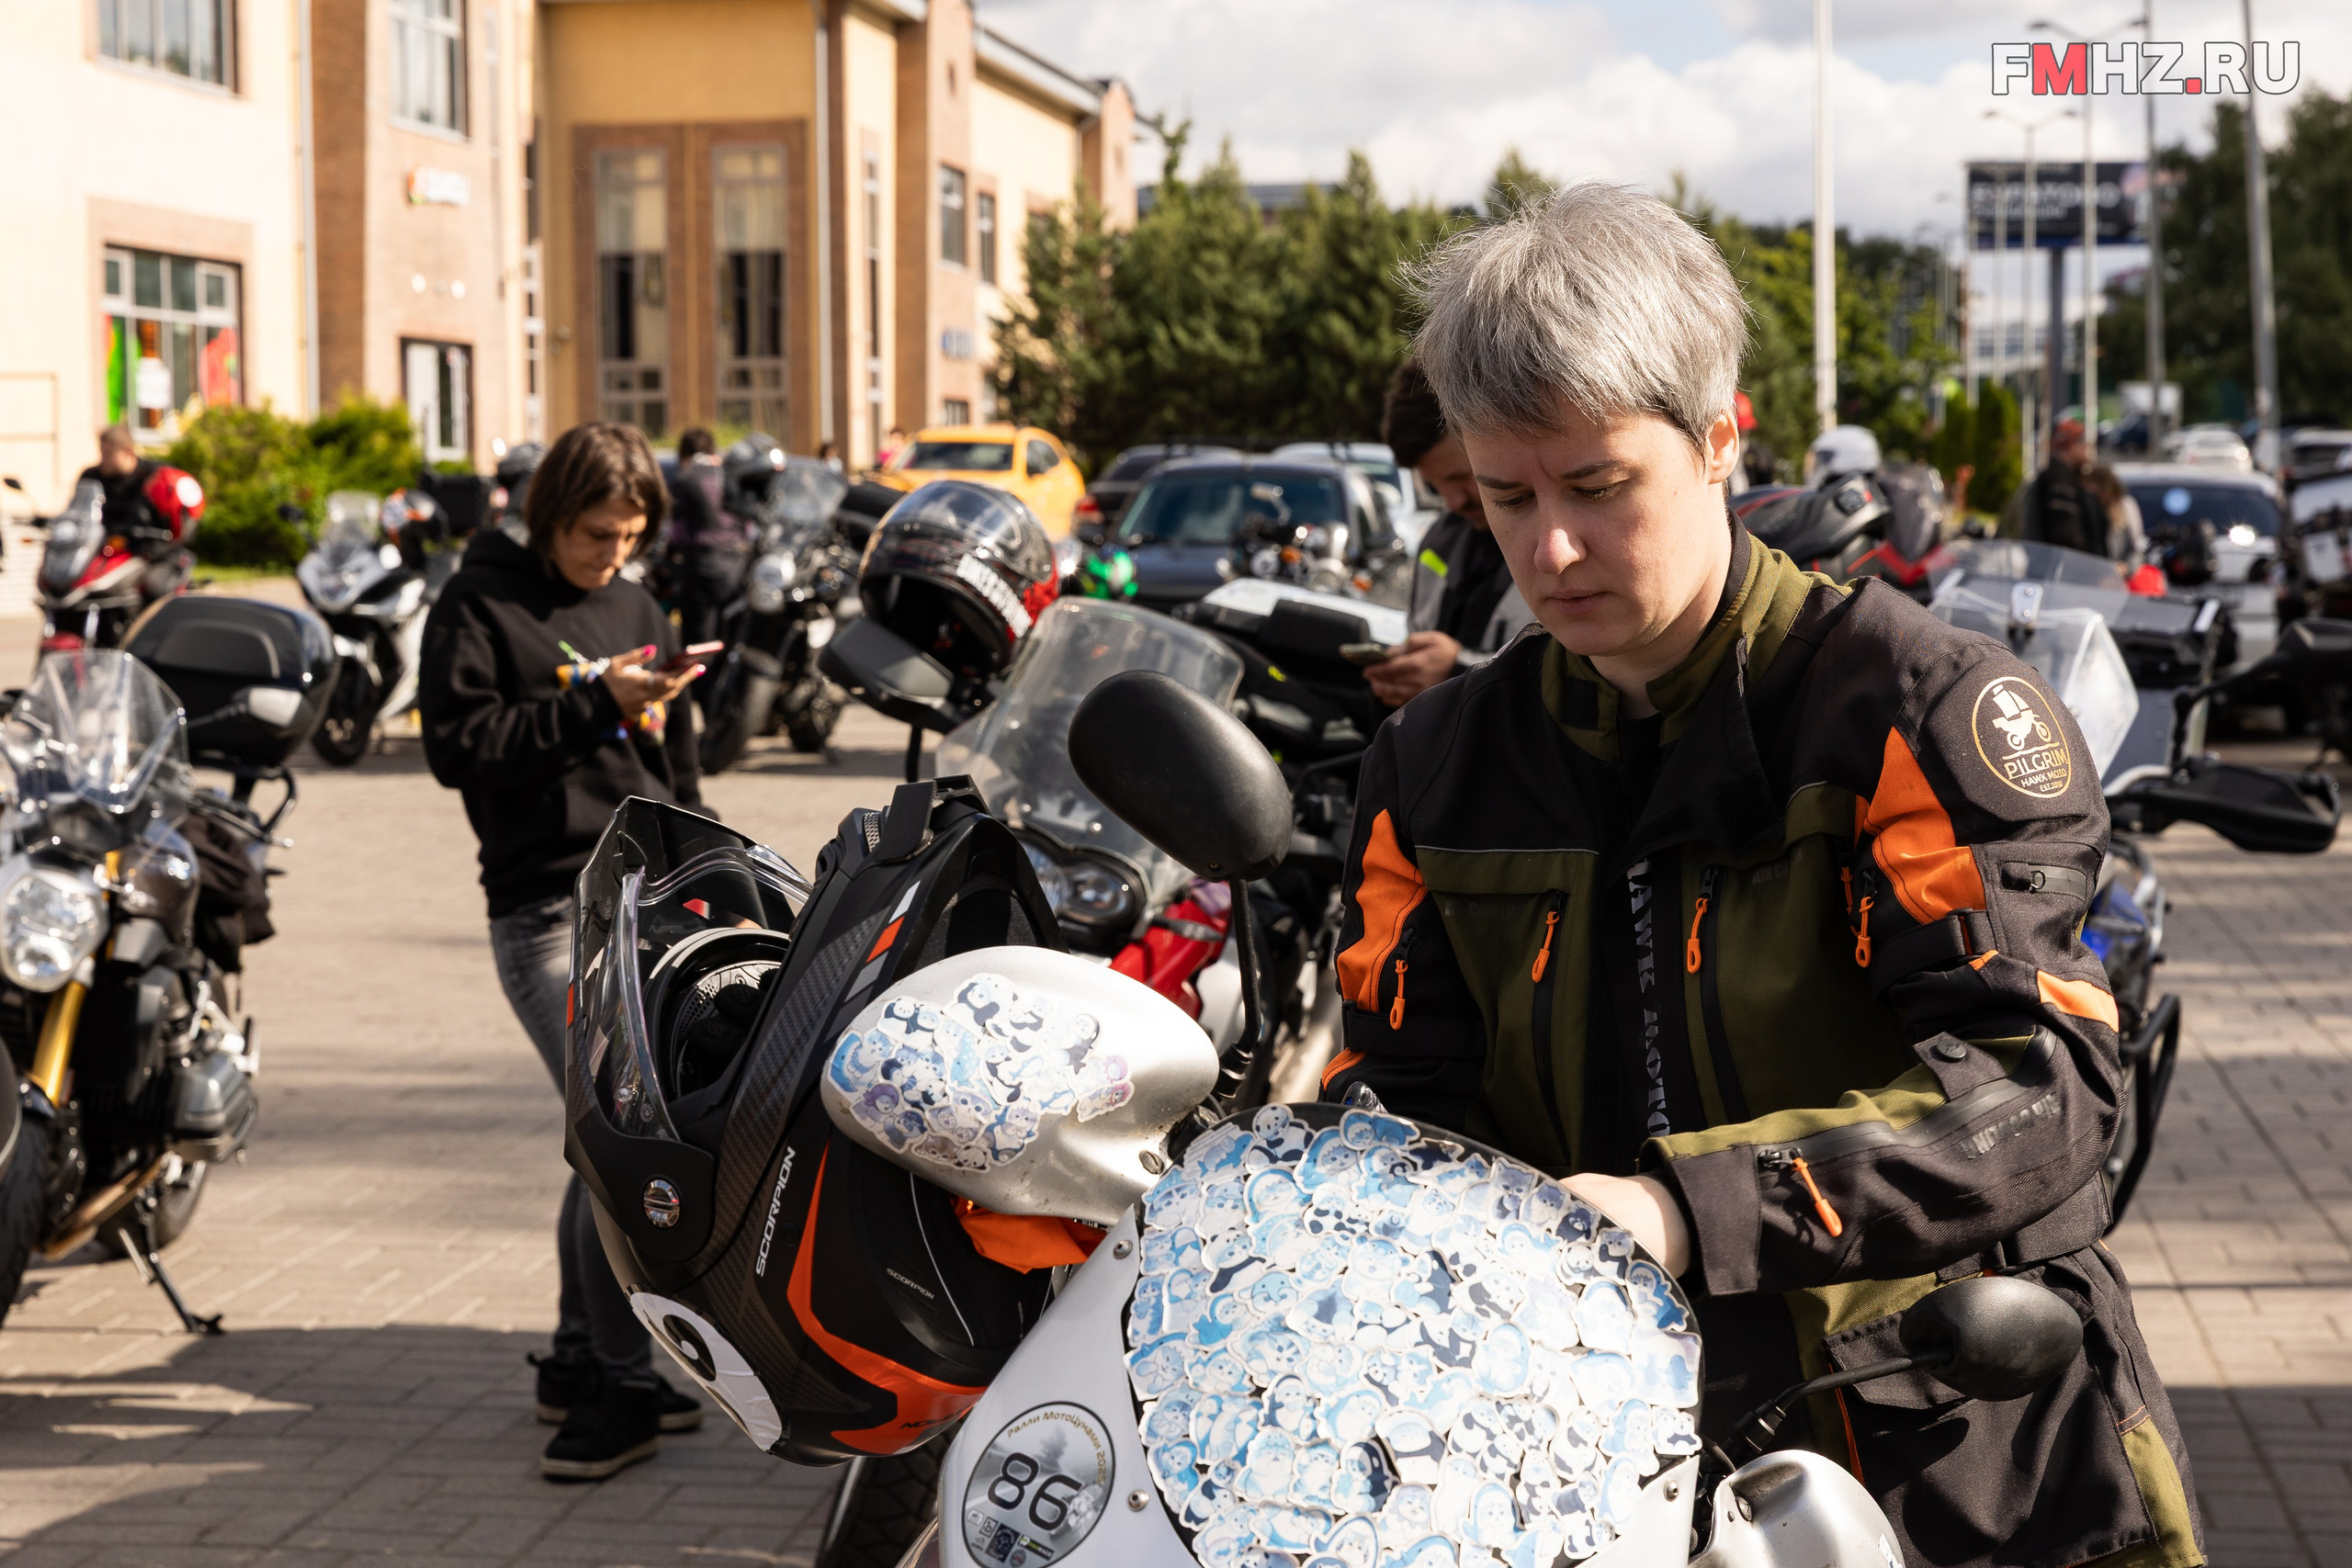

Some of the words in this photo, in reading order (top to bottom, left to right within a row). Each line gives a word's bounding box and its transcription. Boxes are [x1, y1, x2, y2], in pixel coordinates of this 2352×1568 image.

[2004, 748, 2068, 780] PILGRIM
[2021, 773, 2048, 787] HAWK
[2047, 768, 2067, 780] MOTO
[755, 1146, 796, 1277] SCORPION
[887, 1268, 934, 1300] SCORPION
[988, 1452, 1082, 1531] 86
